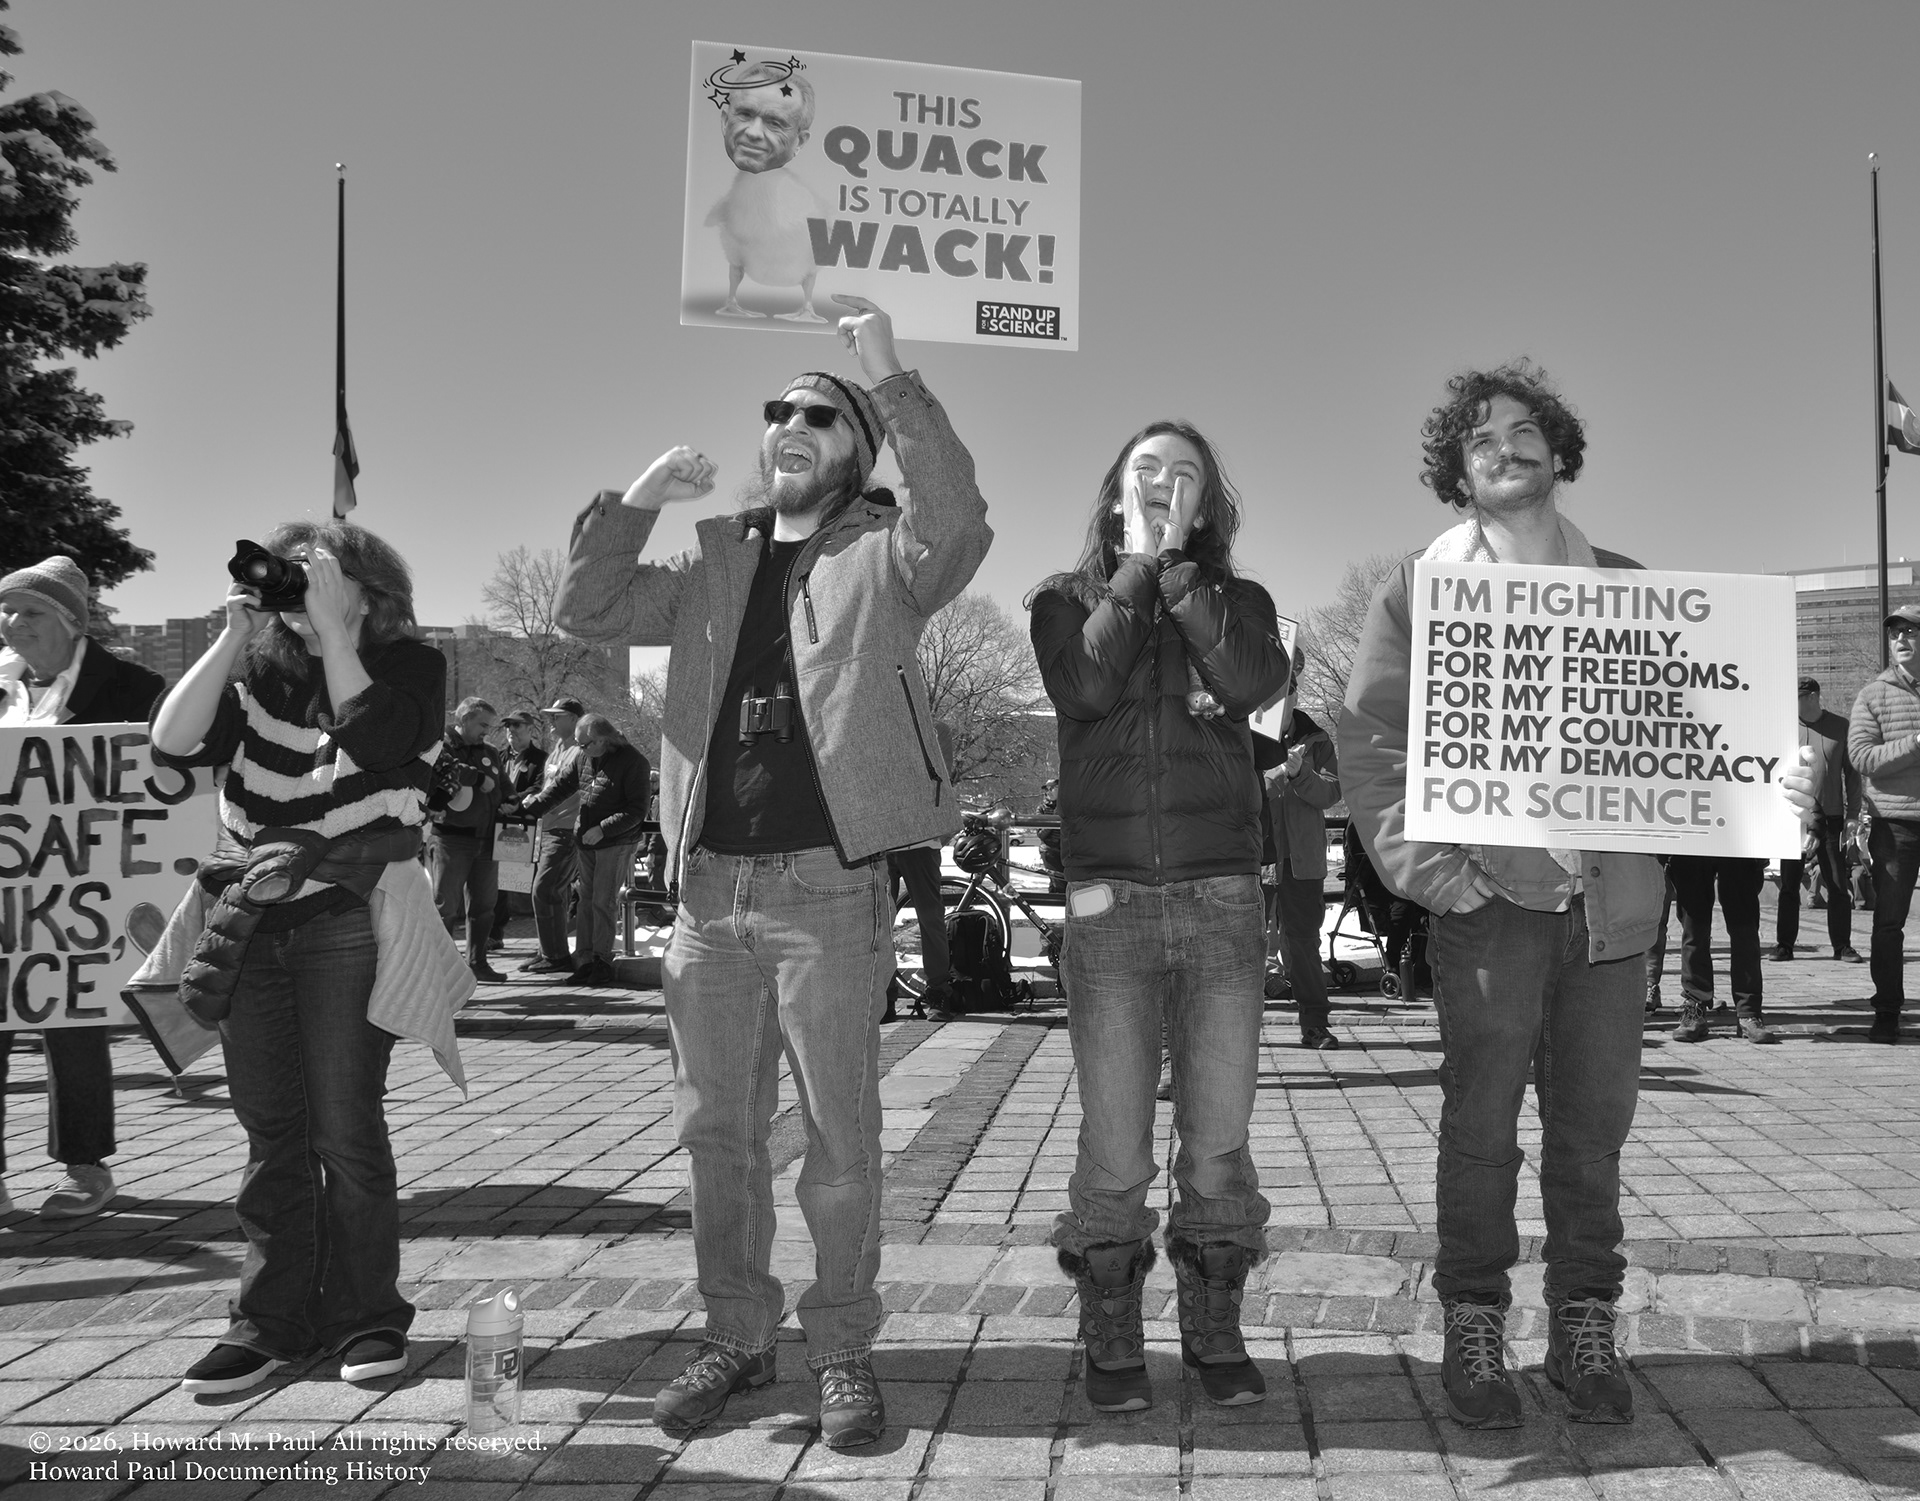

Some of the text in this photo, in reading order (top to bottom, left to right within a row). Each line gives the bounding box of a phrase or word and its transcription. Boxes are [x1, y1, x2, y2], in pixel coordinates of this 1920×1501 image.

[893, 91, 982, 129] THIS
[823, 125, 1049, 184] QUACK
[838, 184, 1031, 226] IS TOTALLY
[806, 217, 1056, 284] WACK!
[981, 304, 1056, 322] STAND UP
[989, 319, 1054, 336] SCIENCE
[1430, 577, 1712, 623] I’M FIGHTING
[1428, 621, 1688, 658] FOR MY FAMILY.
[1427, 651, 1750, 691] FOR MY FREEDOMS.
[1426, 680, 1694, 719] FOR MY FUTURE.
[1425, 711, 1729, 751] FOR MY COUNTRY.
[0, 733, 196, 805] ANES
[1424, 741, 1492, 770] FOR
[1499, 744, 1552, 772] MY
[1423, 777, 1726, 828] FOR SCIENCE.
[0, 808, 199, 879] SAFE.
